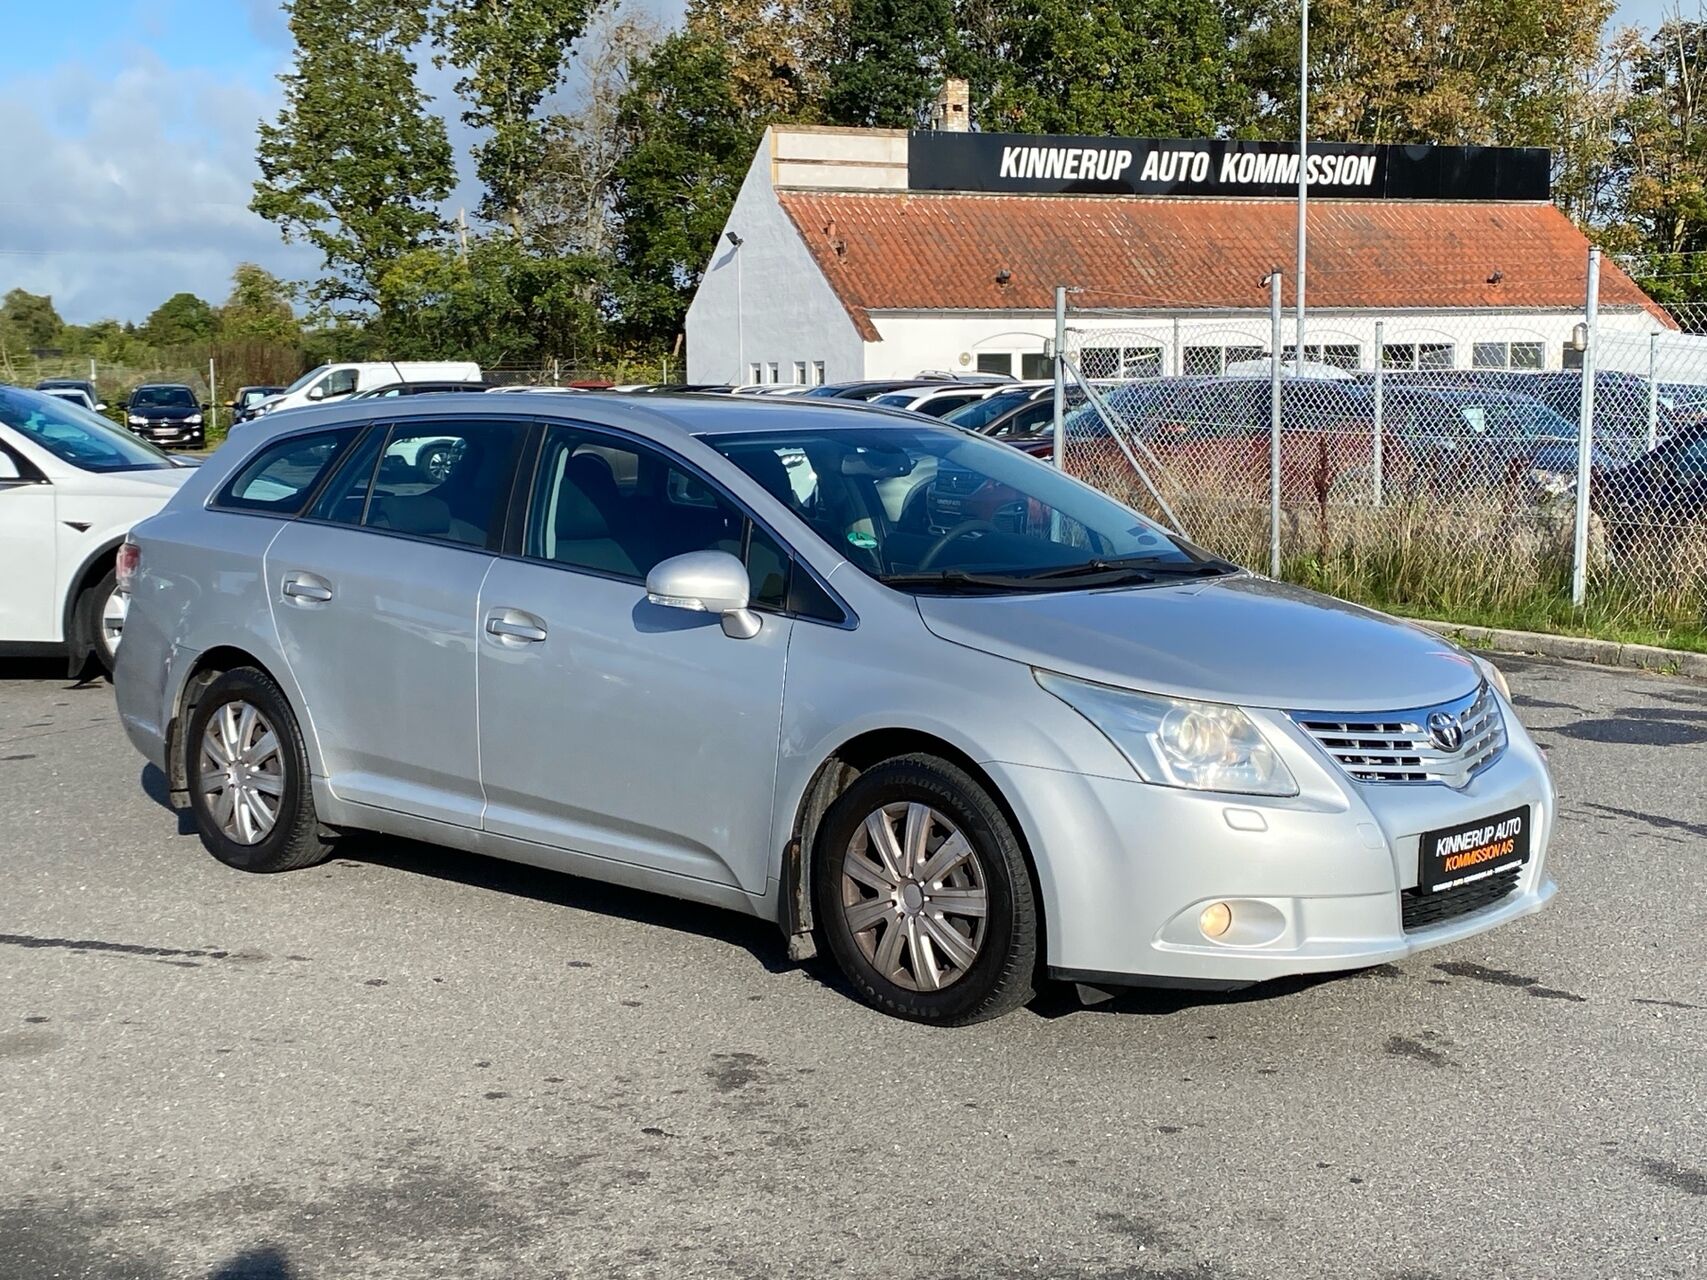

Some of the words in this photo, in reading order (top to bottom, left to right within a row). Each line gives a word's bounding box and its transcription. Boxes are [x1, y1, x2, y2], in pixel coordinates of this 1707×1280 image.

[1000, 147, 1132, 180] KINNERUP
[1140, 151, 1210, 182] AUTO
[1219, 153, 1377, 186] KOMMSSION
[1436, 826, 1495, 857] KINNERUP
[1494, 817, 1521, 841] AUTO
[1445, 843, 1501, 872] KOMMISSION
[1500, 839, 1515, 857] A/S
